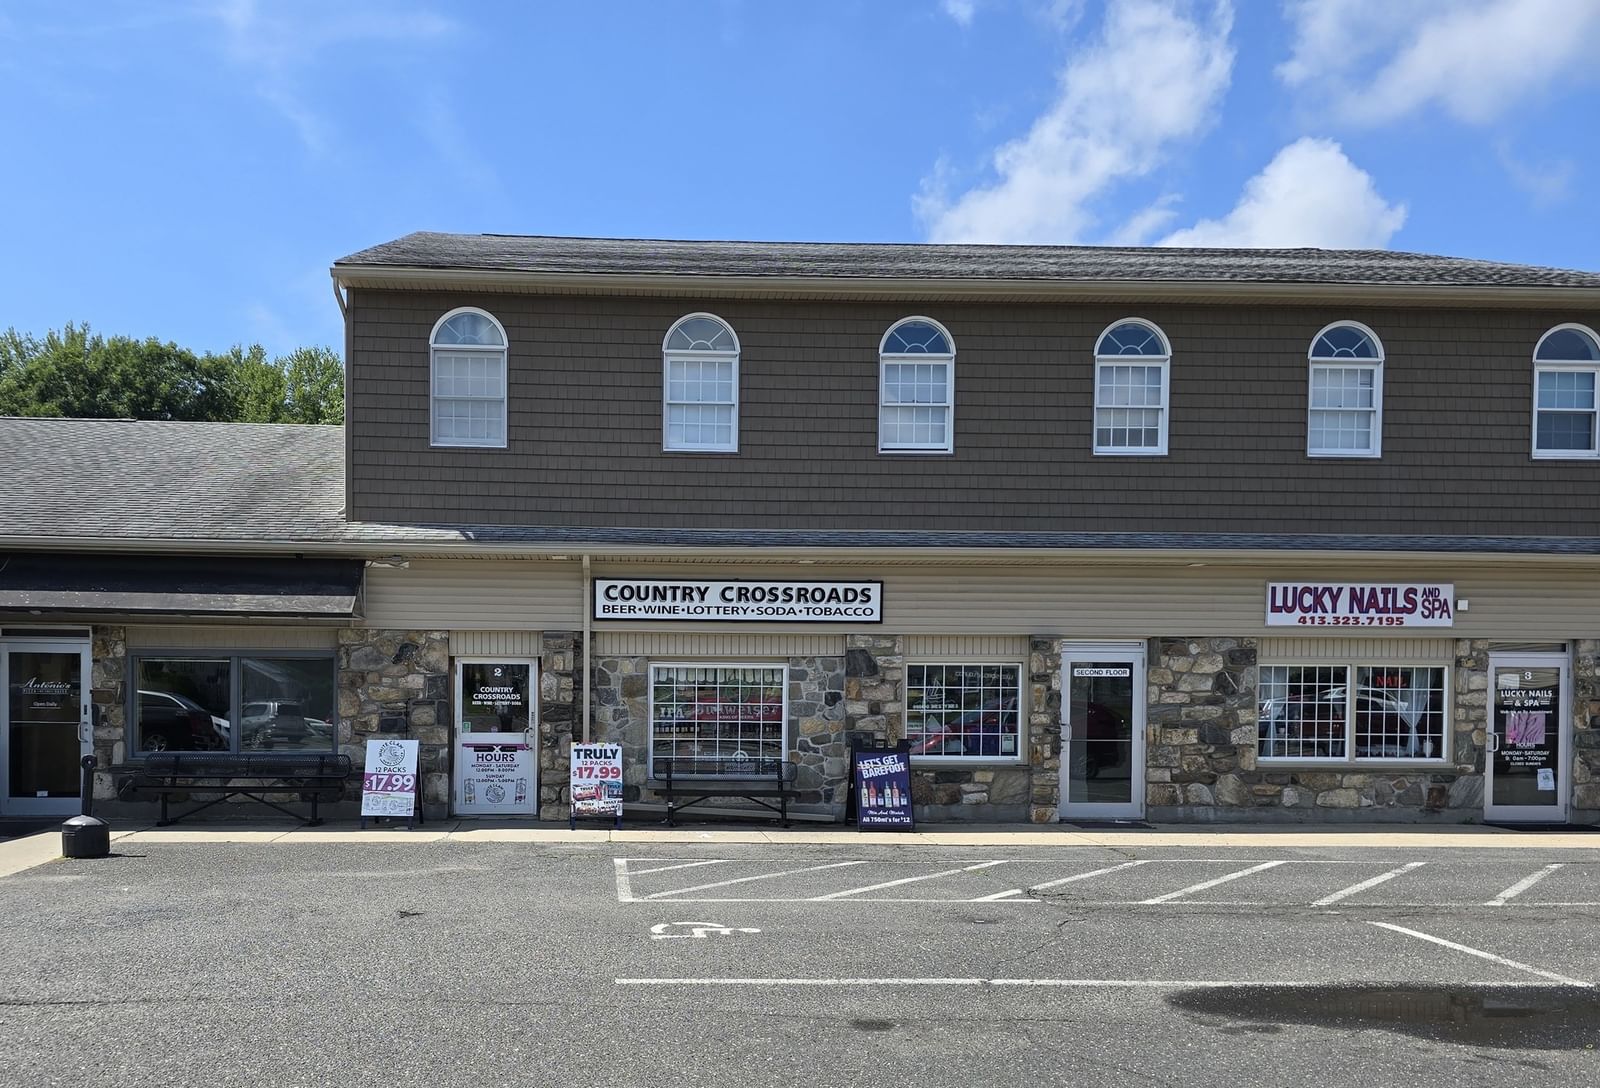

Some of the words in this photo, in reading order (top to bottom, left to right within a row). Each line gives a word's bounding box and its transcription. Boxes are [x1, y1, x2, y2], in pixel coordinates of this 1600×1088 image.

[603, 585, 710, 602] COUNTRY
[719, 586, 872, 604] CROSSROADS
[1421, 588, 1440, 598] AND
[1270, 586, 1344, 614] LUCKY
[1350, 587, 1418, 614] NAILS
[1421, 598, 1451, 619] SPA
[1298, 616, 1404, 625] 413.323.7195
[494, 668, 502, 677] 2
[1524, 672, 1532, 680] 3
[659, 706, 685, 719] IPA
[476, 753, 515, 762] HOURS
[574, 748, 619, 759] TRULY
[882, 755, 898, 765] GET
[572, 767, 621, 779] $17.99
[861, 762, 905, 779] BAREFOOT
[365, 775, 415, 791] $17.99
